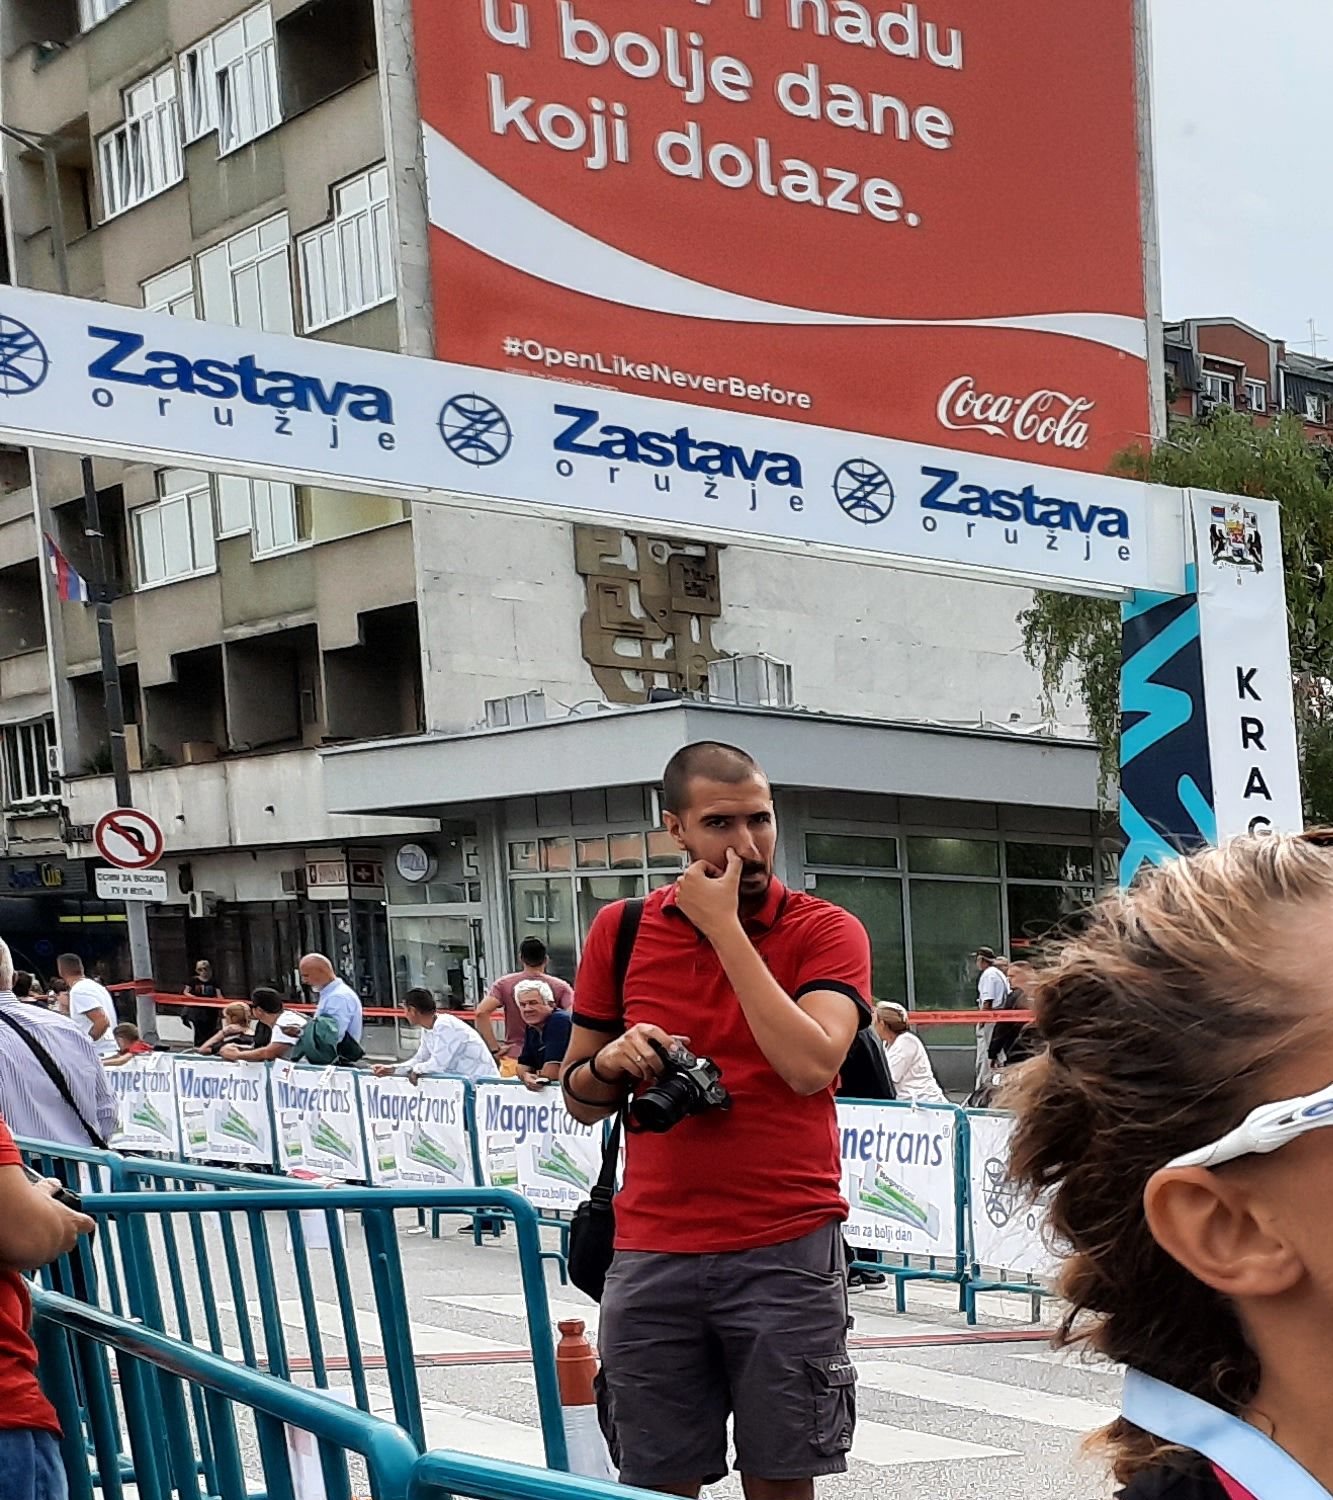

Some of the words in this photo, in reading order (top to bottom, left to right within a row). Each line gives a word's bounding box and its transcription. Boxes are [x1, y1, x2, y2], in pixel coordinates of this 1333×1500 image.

[786, 0, 963, 69] nadu
[480, 0, 530, 48] u
[558, 1, 753, 104] bolje
[775, 63, 954, 150] dane
[487, 73, 629, 169] koji
[655, 122, 921, 227] dolaze.
[87, 325, 395, 425] Zastava
[503, 335, 812, 409] #OpenLikeNeverBefore
[91, 387, 396, 450] oružje
[553, 403, 803, 489] Zastava
[937, 375, 1095, 449] Coca-Cola
[556, 458, 804, 512] oružje
[920, 465, 1130, 540] Zastava
[922, 515, 1131, 561] oružje
[105, 1066, 171, 1101] agnetrans
[178, 1066, 259, 1108] Magnetrans
[366, 1084, 457, 1131] Magnetrans
[840, 1123, 943, 1167] netrans
